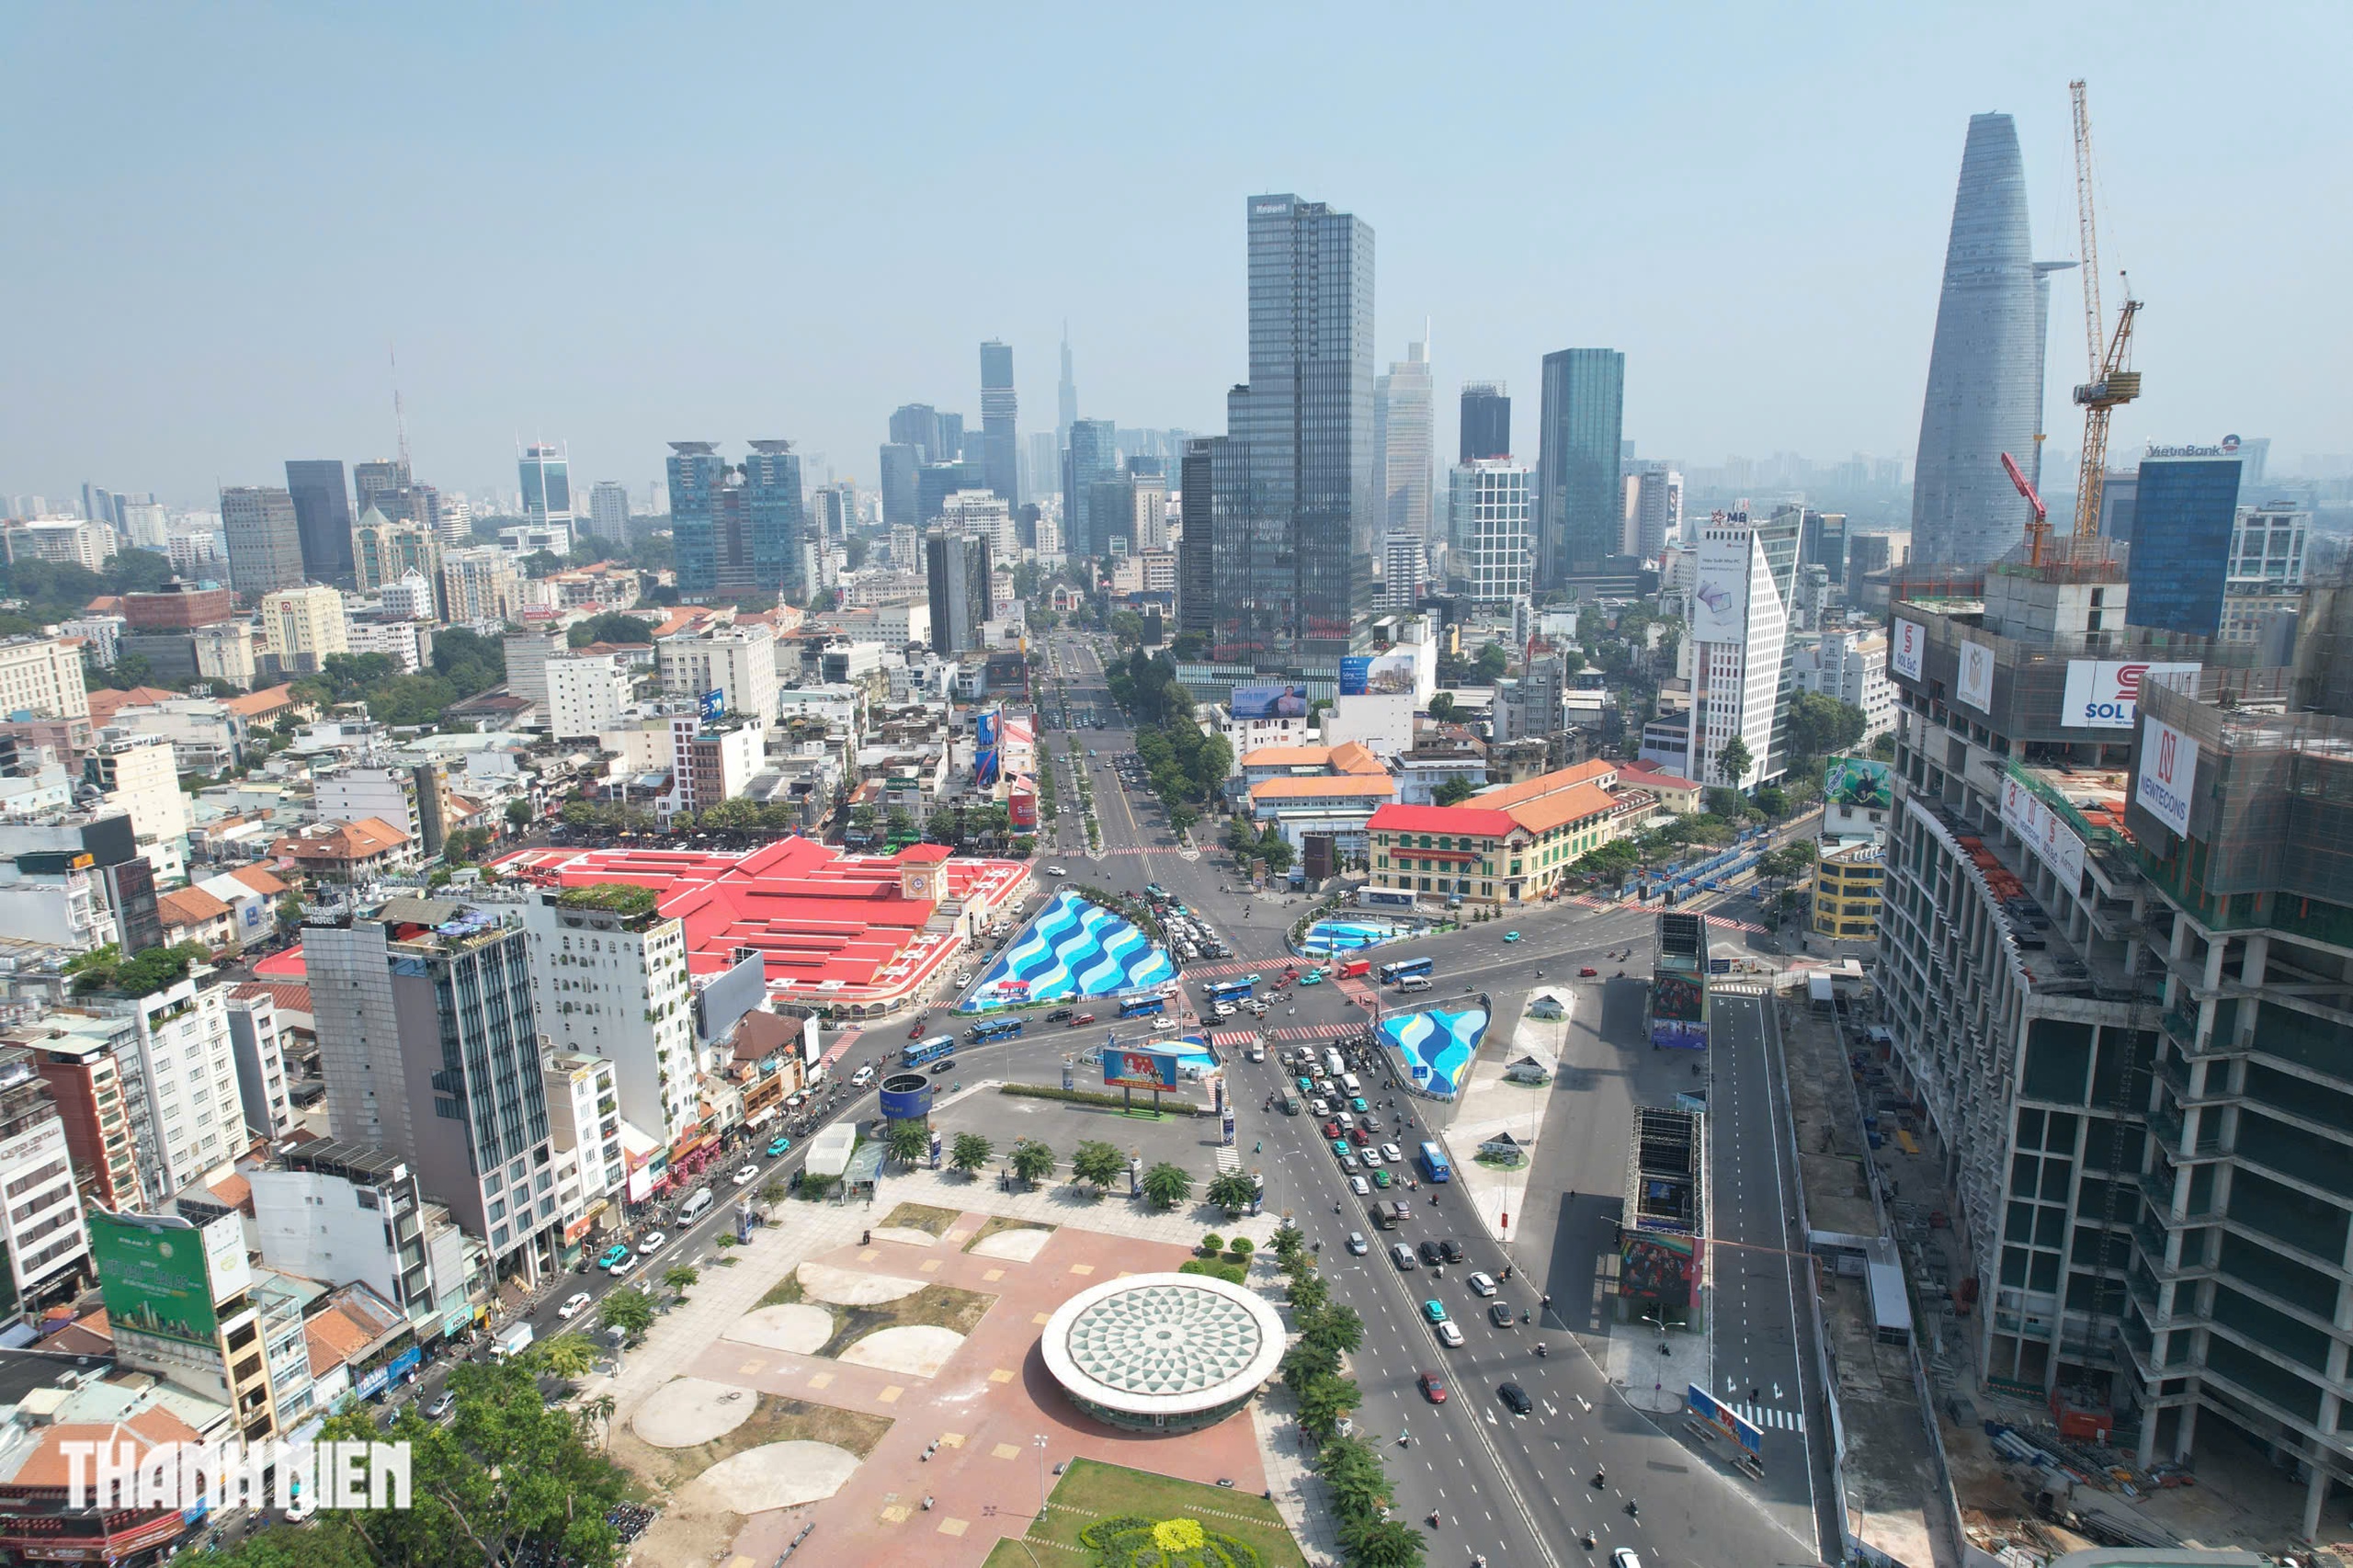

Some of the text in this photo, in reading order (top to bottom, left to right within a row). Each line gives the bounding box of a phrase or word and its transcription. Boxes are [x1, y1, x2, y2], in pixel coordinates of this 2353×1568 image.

[2149, 445, 2222, 458] VietinBank
[1728, 512, 1746, 522] MB
[2086, 703, 2125, 719] SOL
[1825, 765, 1847, 793] TUBORG
[2140, 774, 2187, 821] NEWTECONS
[310, 915, 337, 925] hotel
